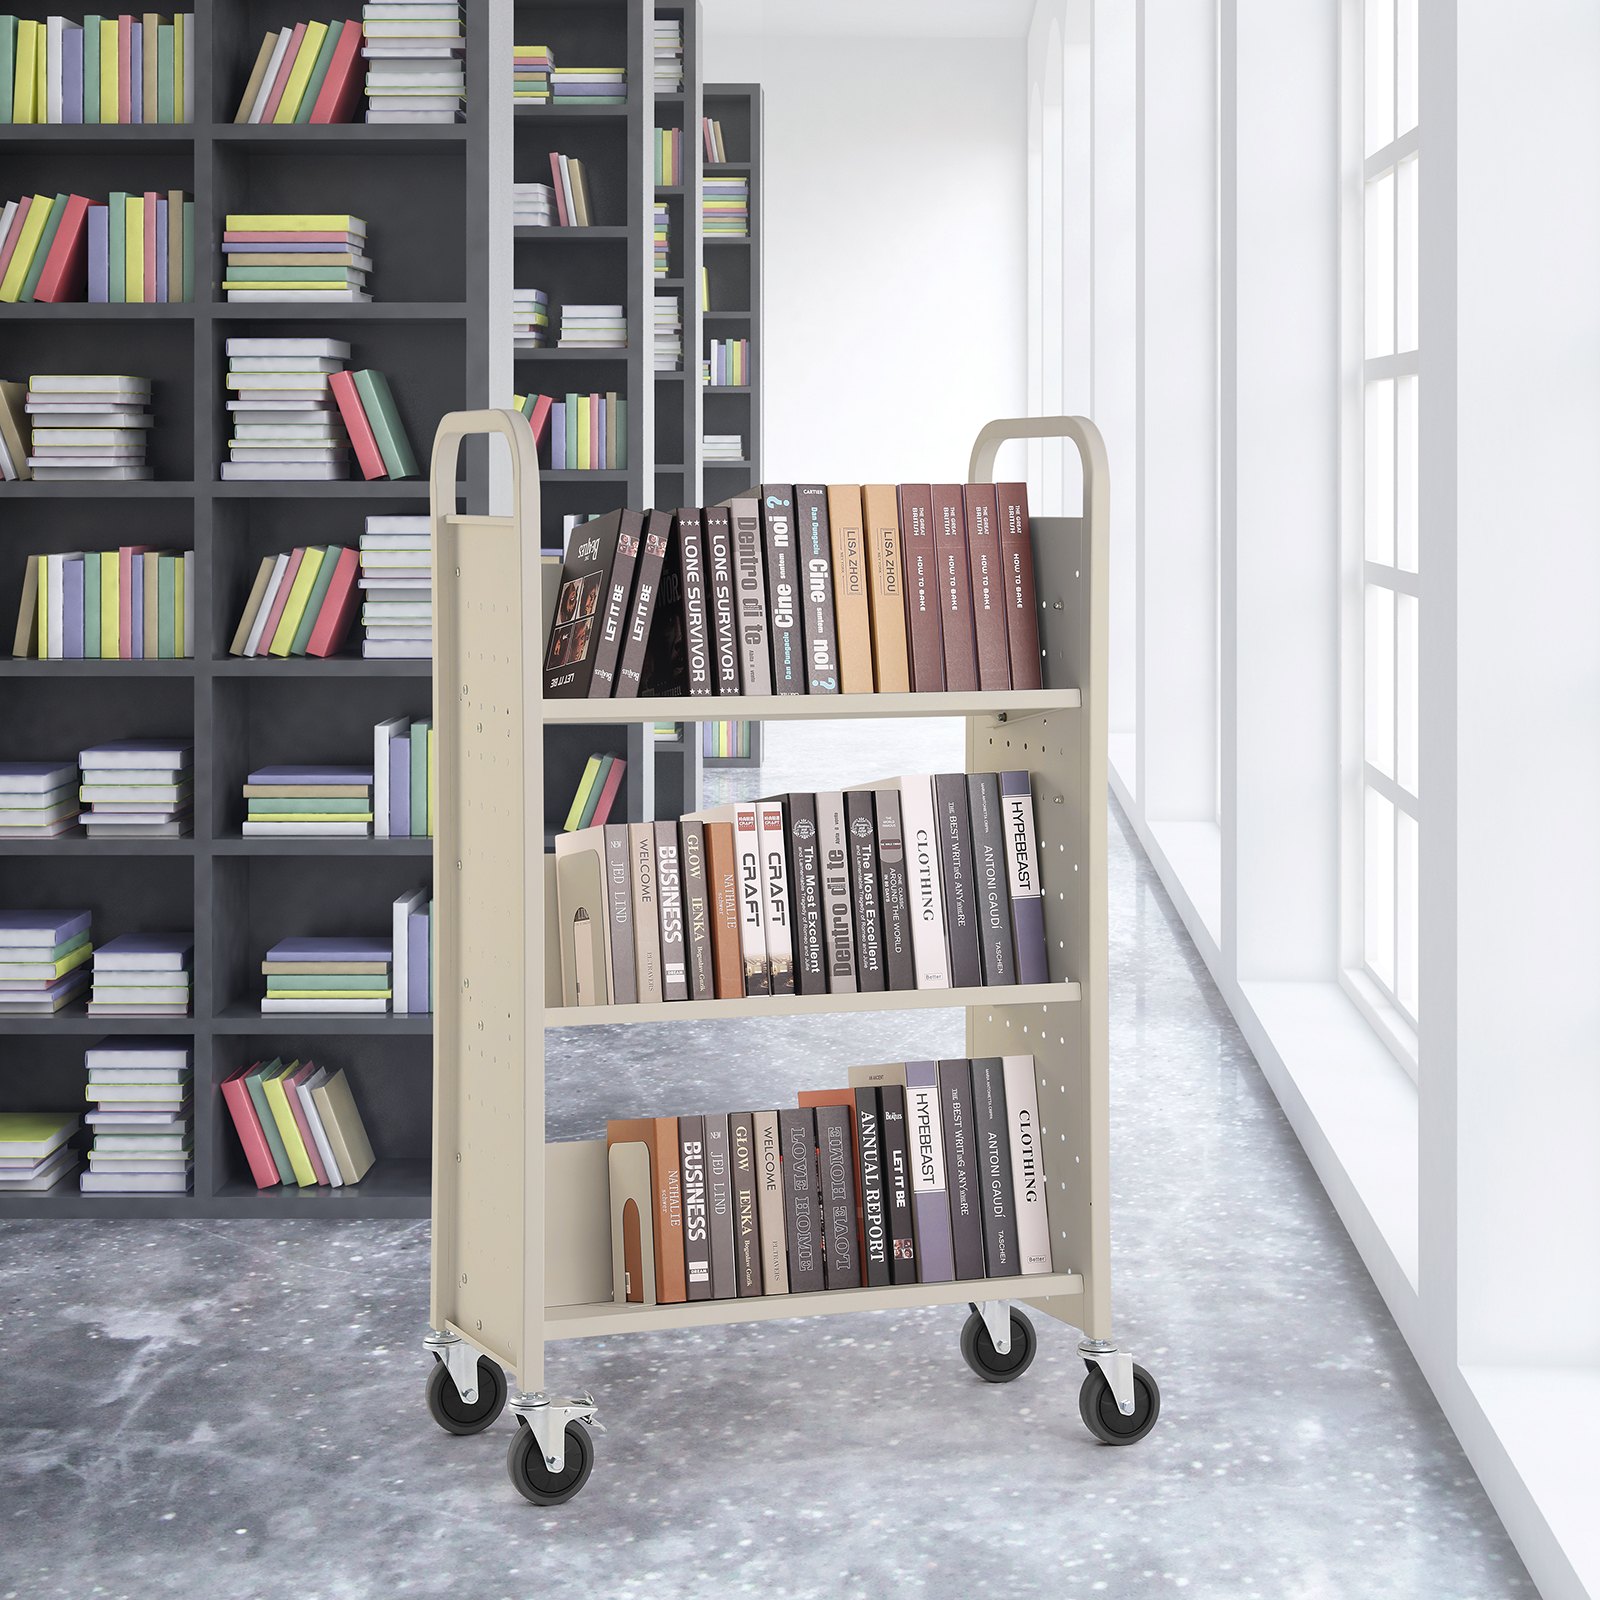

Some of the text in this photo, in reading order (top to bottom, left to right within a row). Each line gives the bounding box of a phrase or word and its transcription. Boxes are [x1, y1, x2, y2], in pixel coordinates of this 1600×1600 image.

[767, 496, 794, 628] Cine noi ?
[812, 523, 821, 555] Dungaciu
[847, 531, 859, 592] LISA ZHOU
[885, 531, 897, 592] LISA ZHOU
[685, 536, 706, 682] LONE SURVIVOR
[713, 536, 734, 681] LONE SURVIVOR
[737, 518, 763, 644] Dentro di te
[918, 578, 924, 587] TO
[949, 577, 955, 587] TO
[982, 576, 988, 586] TO
[1014, 575, 1020, 585] TO
[605, 584, 624, 642] LET IT BE
[632, 584, 652, 642] LET IT BE
[809, 559, 836, 690] Cine noi ?
[564, 672, 575, 685] LET
[783, 632, 791, 664] Dungaciu
[550, 677, 559, 688] BE
[687, 834, 701, 880] GLOW
[949, 816, 958, 840] BEST
[1012, 802, 1030, 890] HYPEBEAST
[611, 861, 626, 923] JED LIND
[639, 839, 651, 902] WELCOME
[659, 846, 682, 944] BUSINESS
[724, 874, 736, 929] NATHALIE
[743, 853, 760, 927] CRAFT
[768, 852, 785, 926] CRAFT
[916, 830, 934, 921] CLOTHING
[804, 846, 820, 973] The Most Excellent
[827, 850, 852, 976] Dentro di te
[862, 845, 878, 971] The Most Excellent
[984, 846, 1003, 973] ANTONI GAUDÍ TASCHEN
[916, 1093, 935, 1184] HYPEBEAST
[953, 1102, 962, 1127] BEST
[736, 1126, 749, 1172] GLOW
[764, 1127, 776, 1191] WELCOME
[893, 1151, 905, 1208] LET IT BE
[1019, 1110, 1037, 1202] CLOTHING
[668, 1170, 680, 1226] NATHALIE
[684, 1142, 706, 1241] BUSINESS
[710, 1152, 726, 1214] JED LIND
[791, 1128, 813, 1271] LOVE HOME
[828, 1127, 850, 1270] LOVE HOME
[861, 1111, 884, 1262] ANNUAL REPORT
[988, 1132, 1006, 1264] ANTONI GAUDÍ TASCHEN
